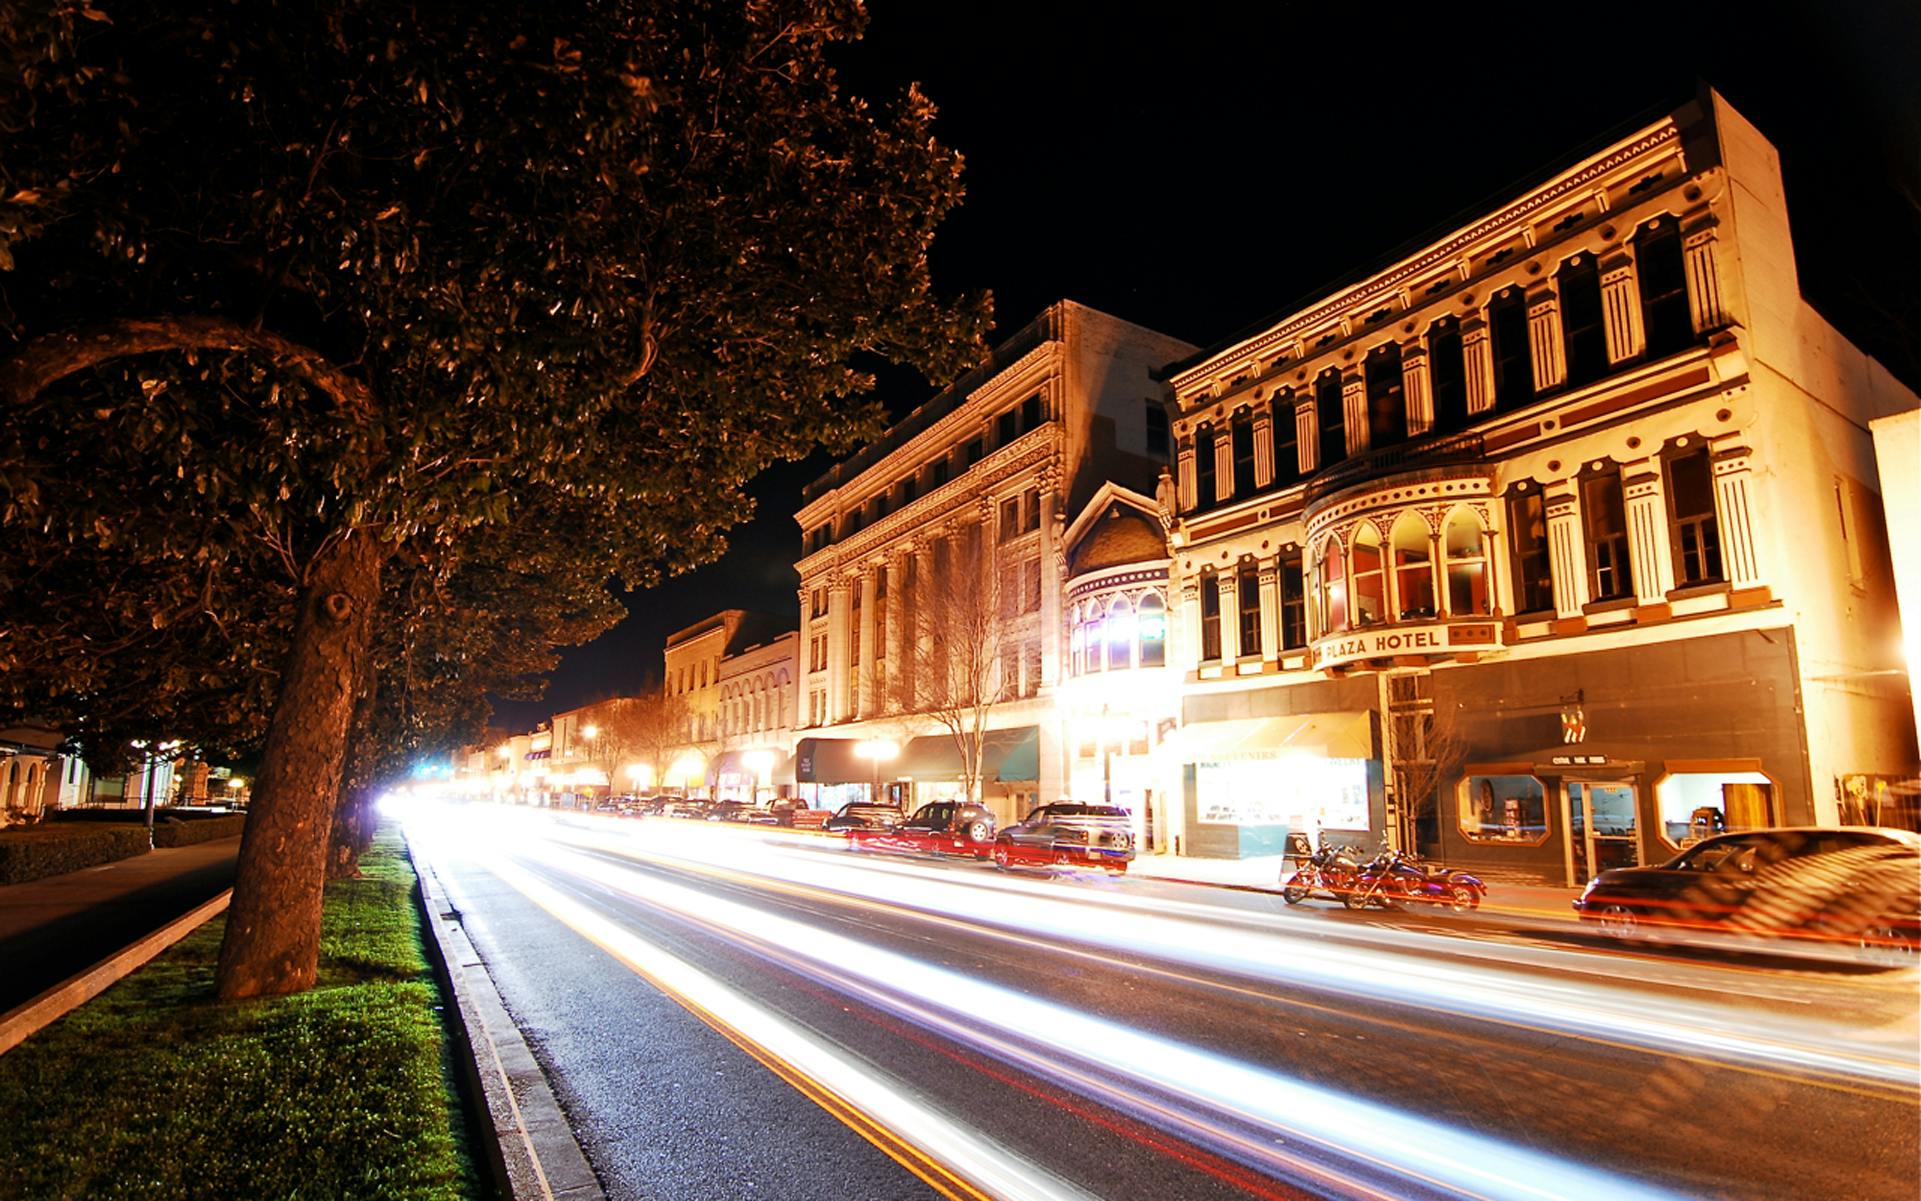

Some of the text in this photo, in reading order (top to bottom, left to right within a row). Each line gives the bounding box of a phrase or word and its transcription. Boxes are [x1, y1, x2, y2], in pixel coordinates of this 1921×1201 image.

[1326, 632, 1440, 659] PLAZA HOTEL
[1210, 751, 1277, 761] VENIRS
